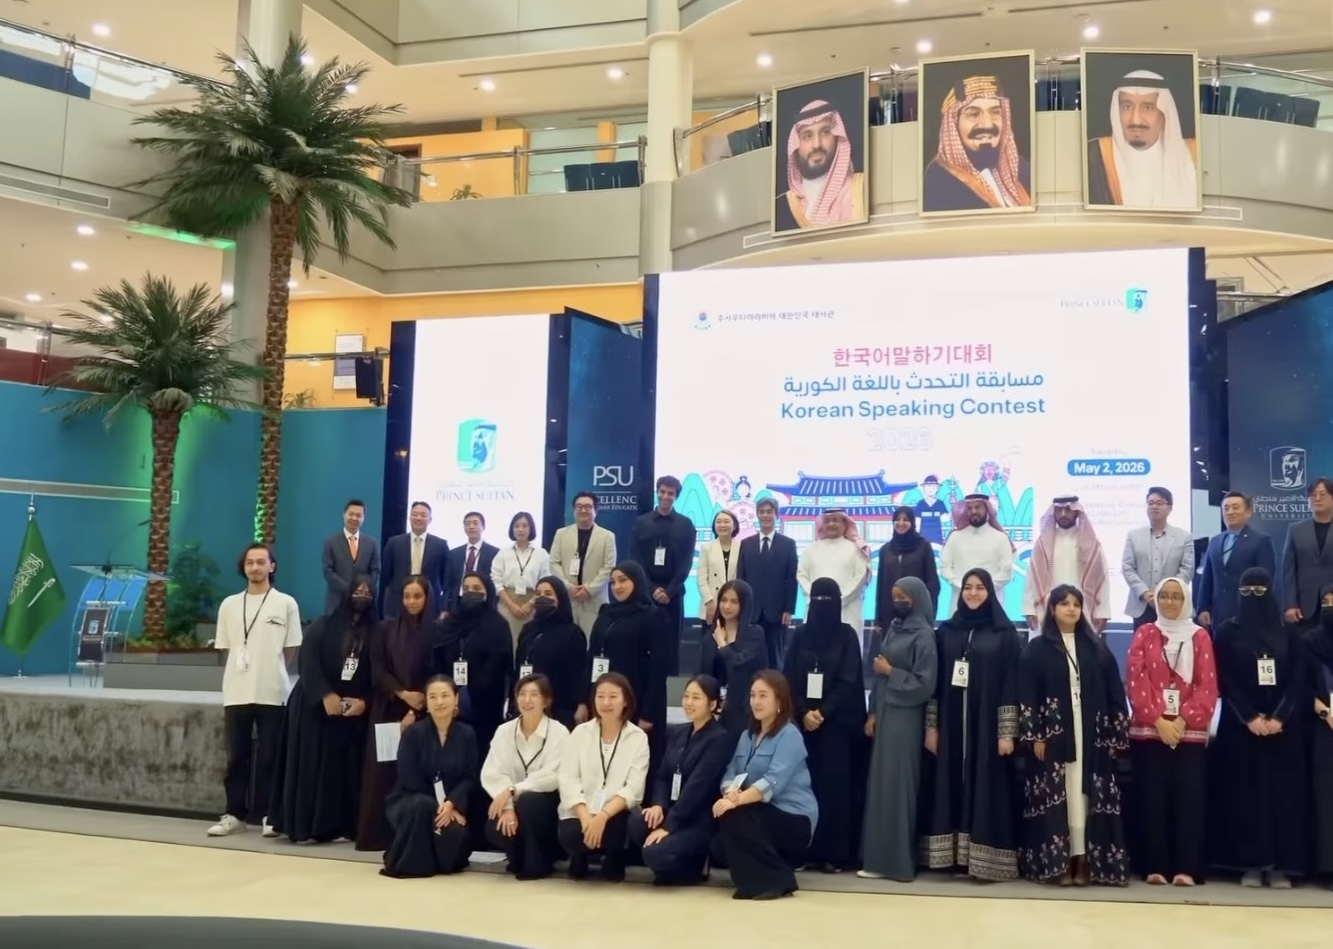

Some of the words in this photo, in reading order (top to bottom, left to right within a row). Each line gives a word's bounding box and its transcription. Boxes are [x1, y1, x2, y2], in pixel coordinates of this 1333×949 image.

[833, 343, 993, 368] 한국어말하기대회
[783, 376, 847, 397] الكورية
[851, 374, 901, 396] باللغة
[905, 371, 970, 390] التحدث
[975, 371, 1044, 393] مسابقة
[781, 401, 854, 419] Korean
[858, 399, 955, 421] Speaking
[960, 398, 1046, 415] Contest
[593, 465, 634, 487] PSU
[1073, 462, 1101, 475] May
[1115, 461, 1146, 473] 2026
[1252, 503, 1288, 513] PRINCE
[455, 667, 466, 676] 14
[597, 664, 605, 673] 3
[1260, 665, 1273, 674] 16
[1168, 694, 1175, 704] 5
